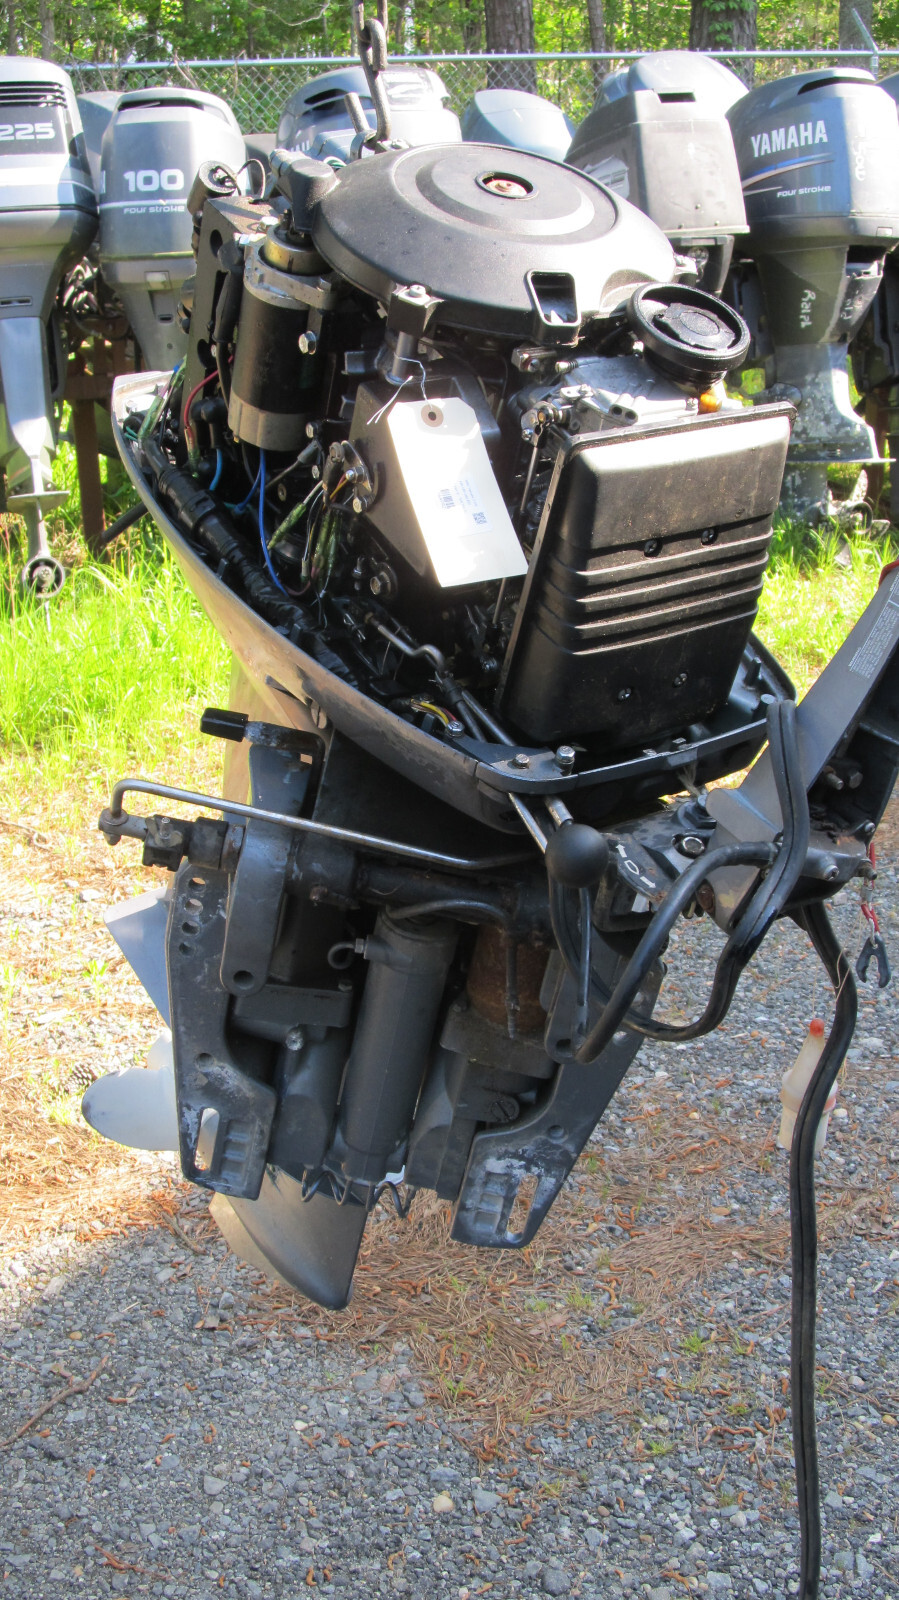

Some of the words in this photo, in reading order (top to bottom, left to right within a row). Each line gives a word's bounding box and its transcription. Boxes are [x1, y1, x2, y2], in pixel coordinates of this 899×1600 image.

[0, 122, 56, 141] 225
[750, 120, 829, 158] YAMAHA
[123, 168, 184, 192] 100
